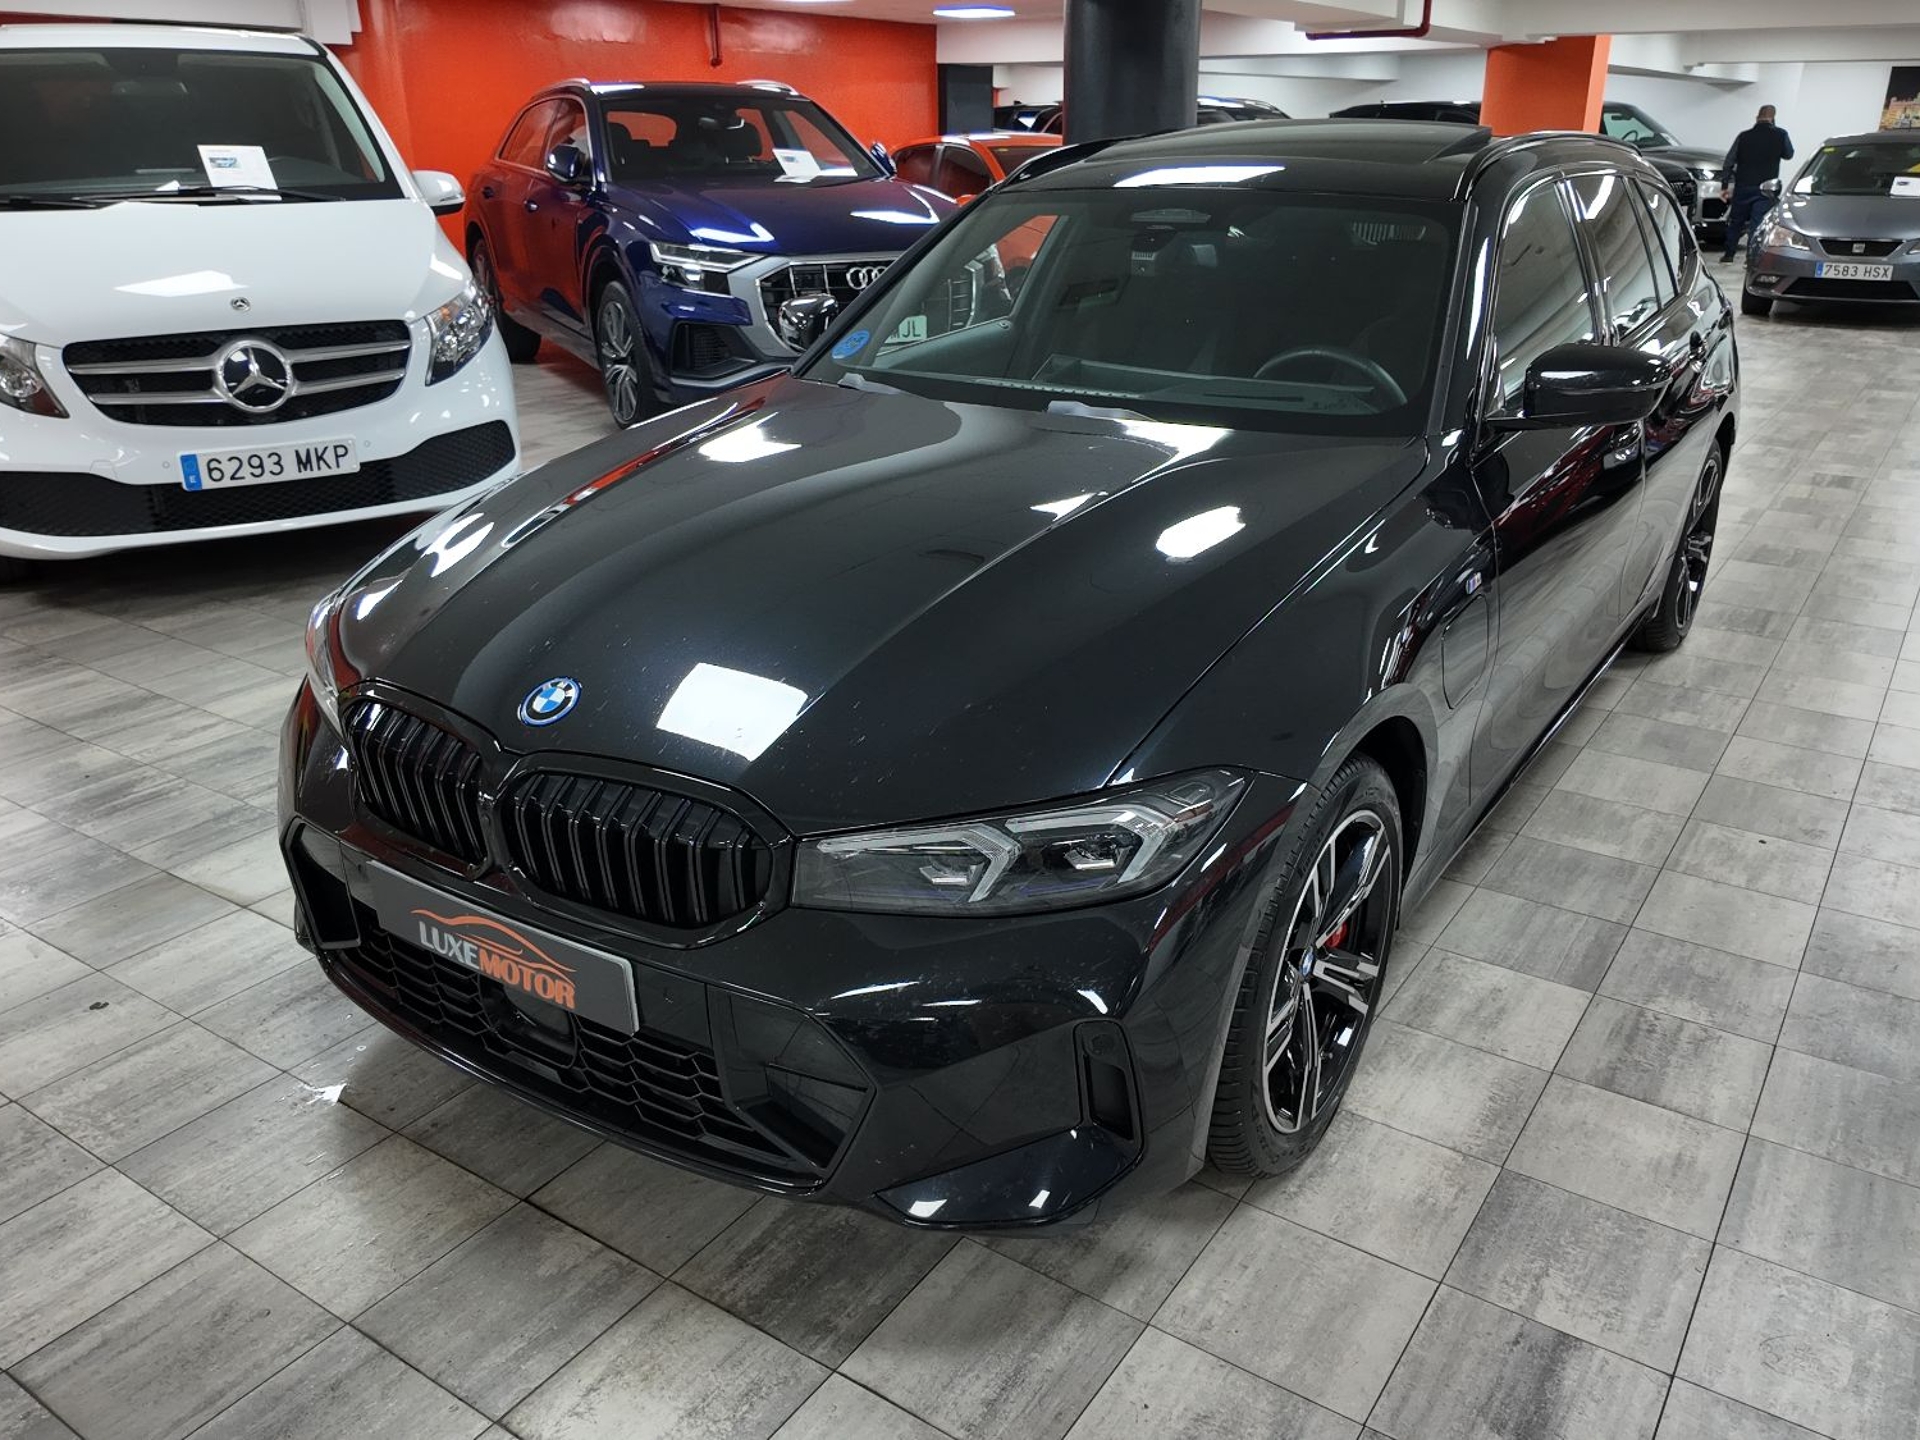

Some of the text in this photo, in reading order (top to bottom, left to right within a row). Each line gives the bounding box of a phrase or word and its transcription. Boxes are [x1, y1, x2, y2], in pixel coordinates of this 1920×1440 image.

[1824, 264, 1890, 279] 7583 HSX
[206, 444, 349, 482] 6293 MKP
[418, 920, 576, 1010] LUXEMOTOR
